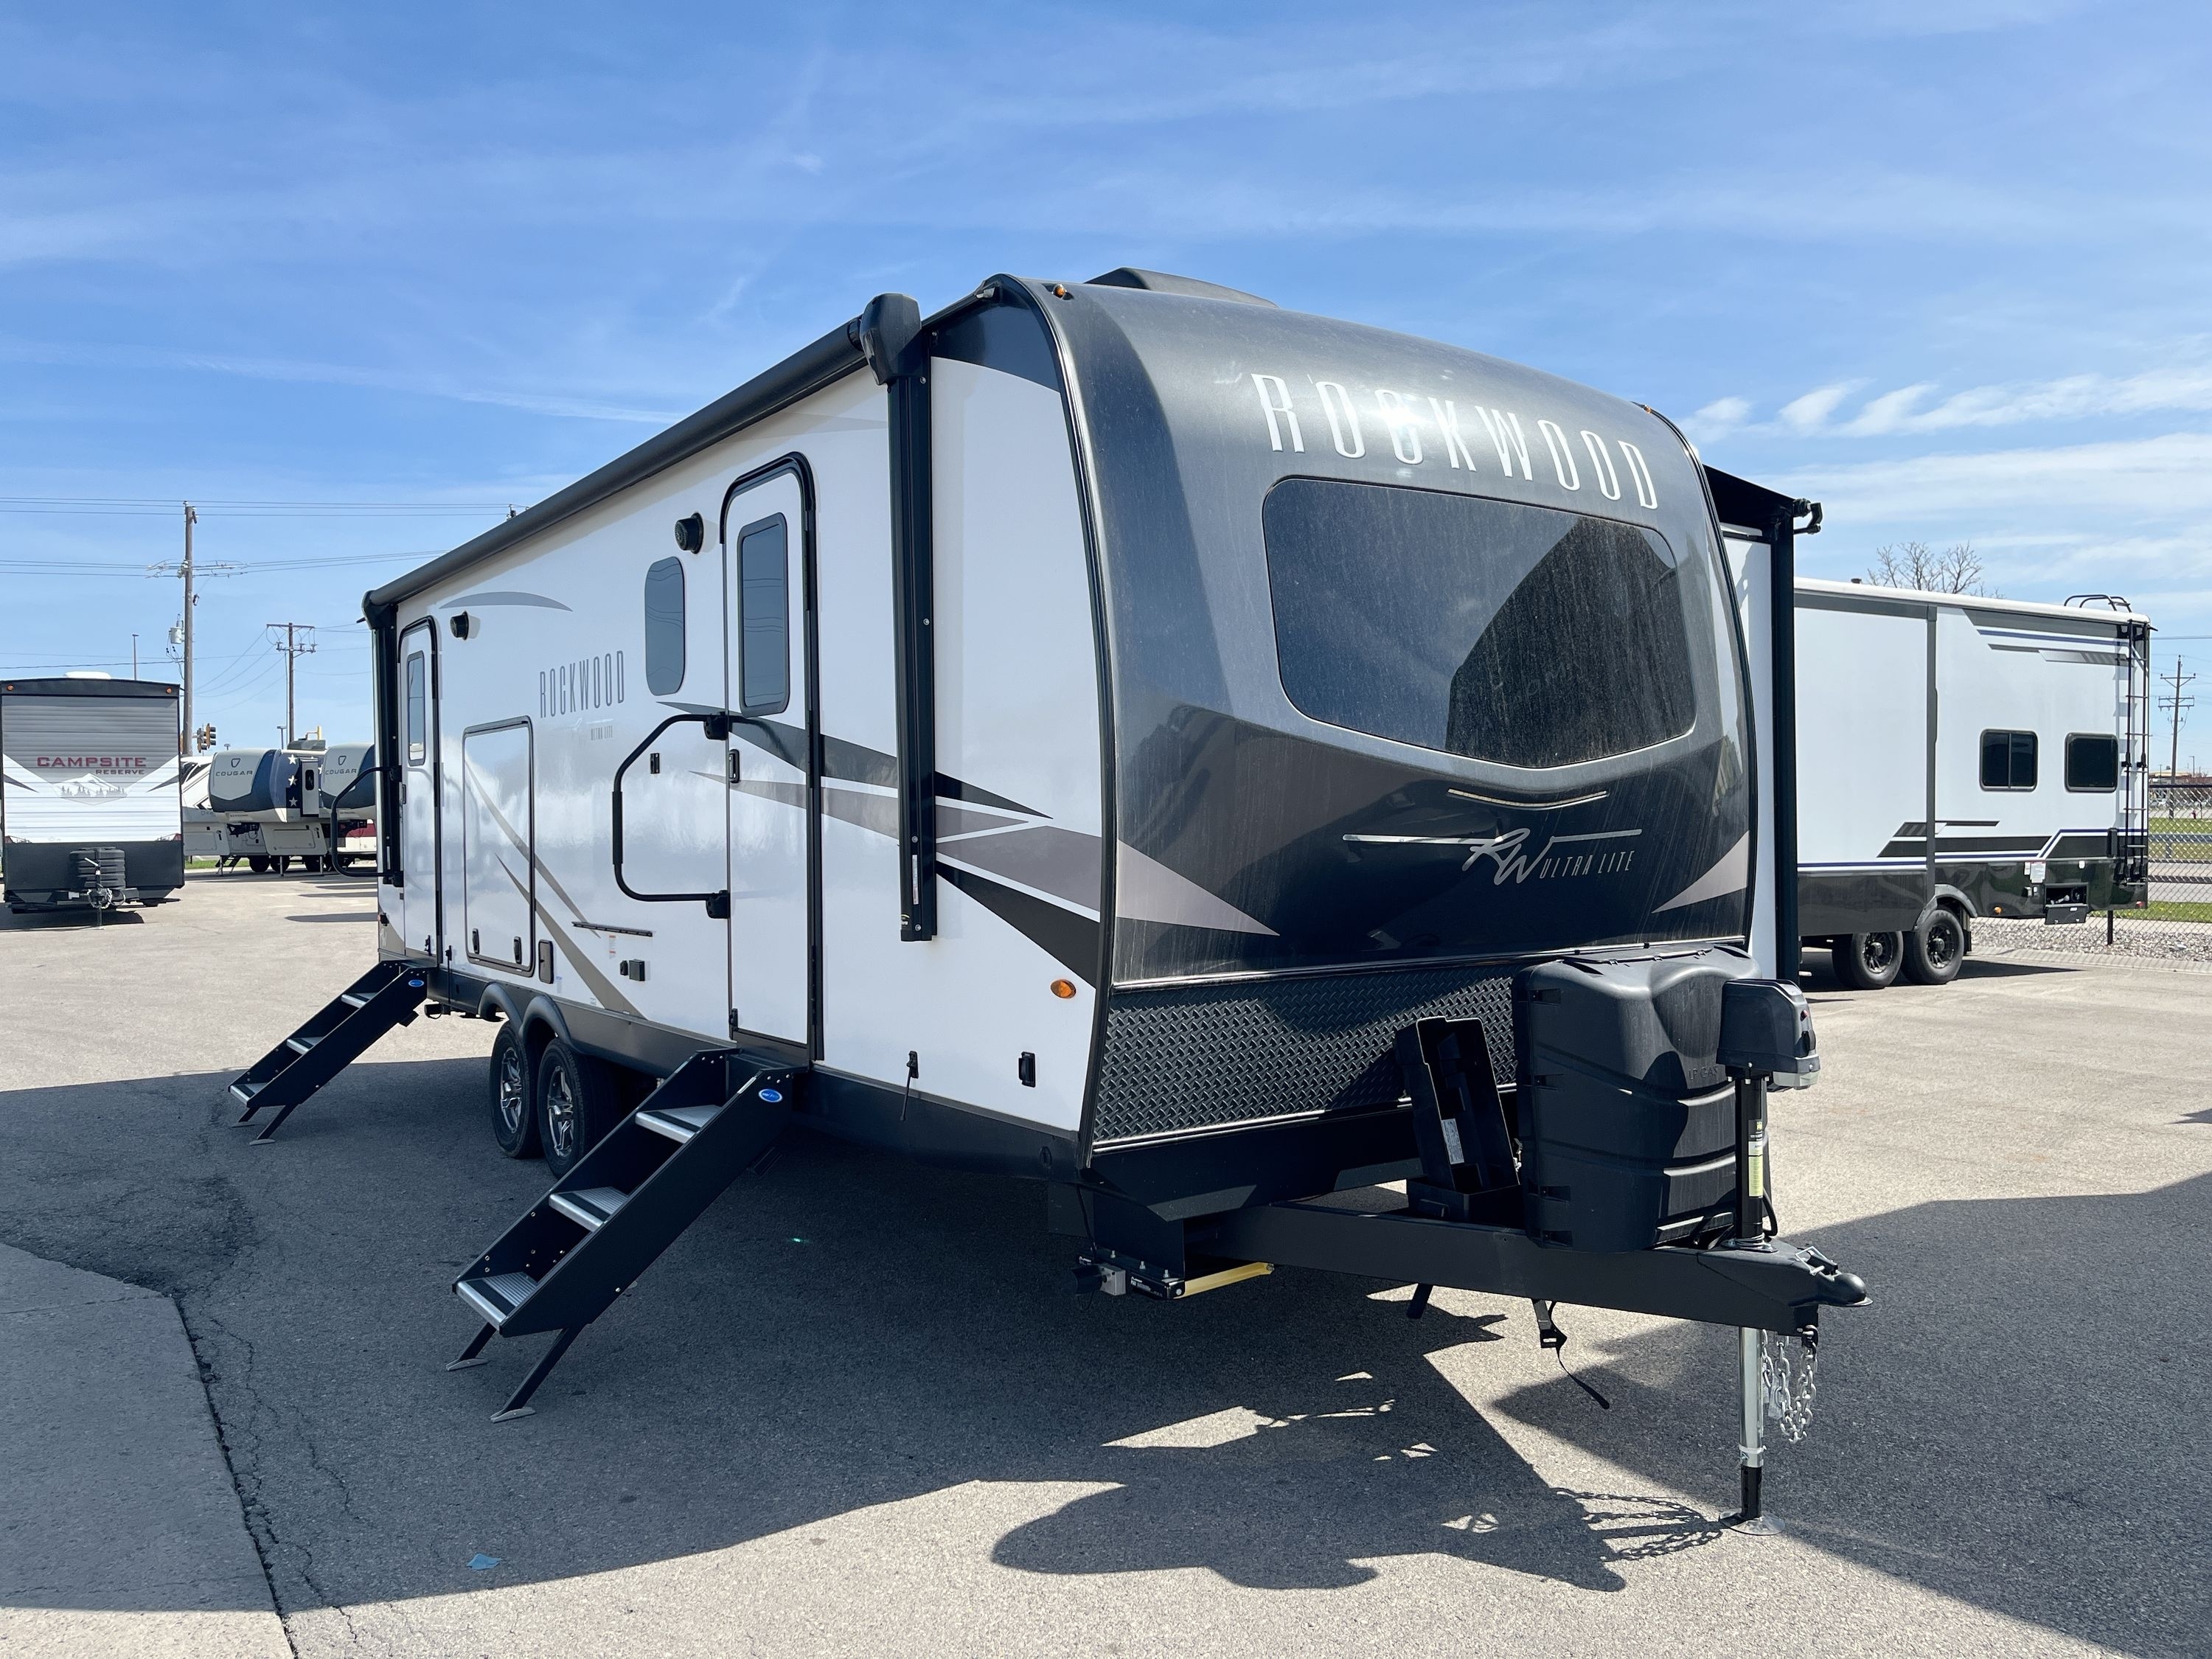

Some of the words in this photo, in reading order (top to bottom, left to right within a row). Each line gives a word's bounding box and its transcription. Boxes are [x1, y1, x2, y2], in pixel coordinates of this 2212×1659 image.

[1251, 373, 1658, 509] ROCKWOOD
[540, 650, 624, 718] ROCKWOOD
[37, 757, 147, 767] CAMPSITE
[1539, 855, 1593, 879] ULTRA
[1597, 850, 1635, 874] LITE
